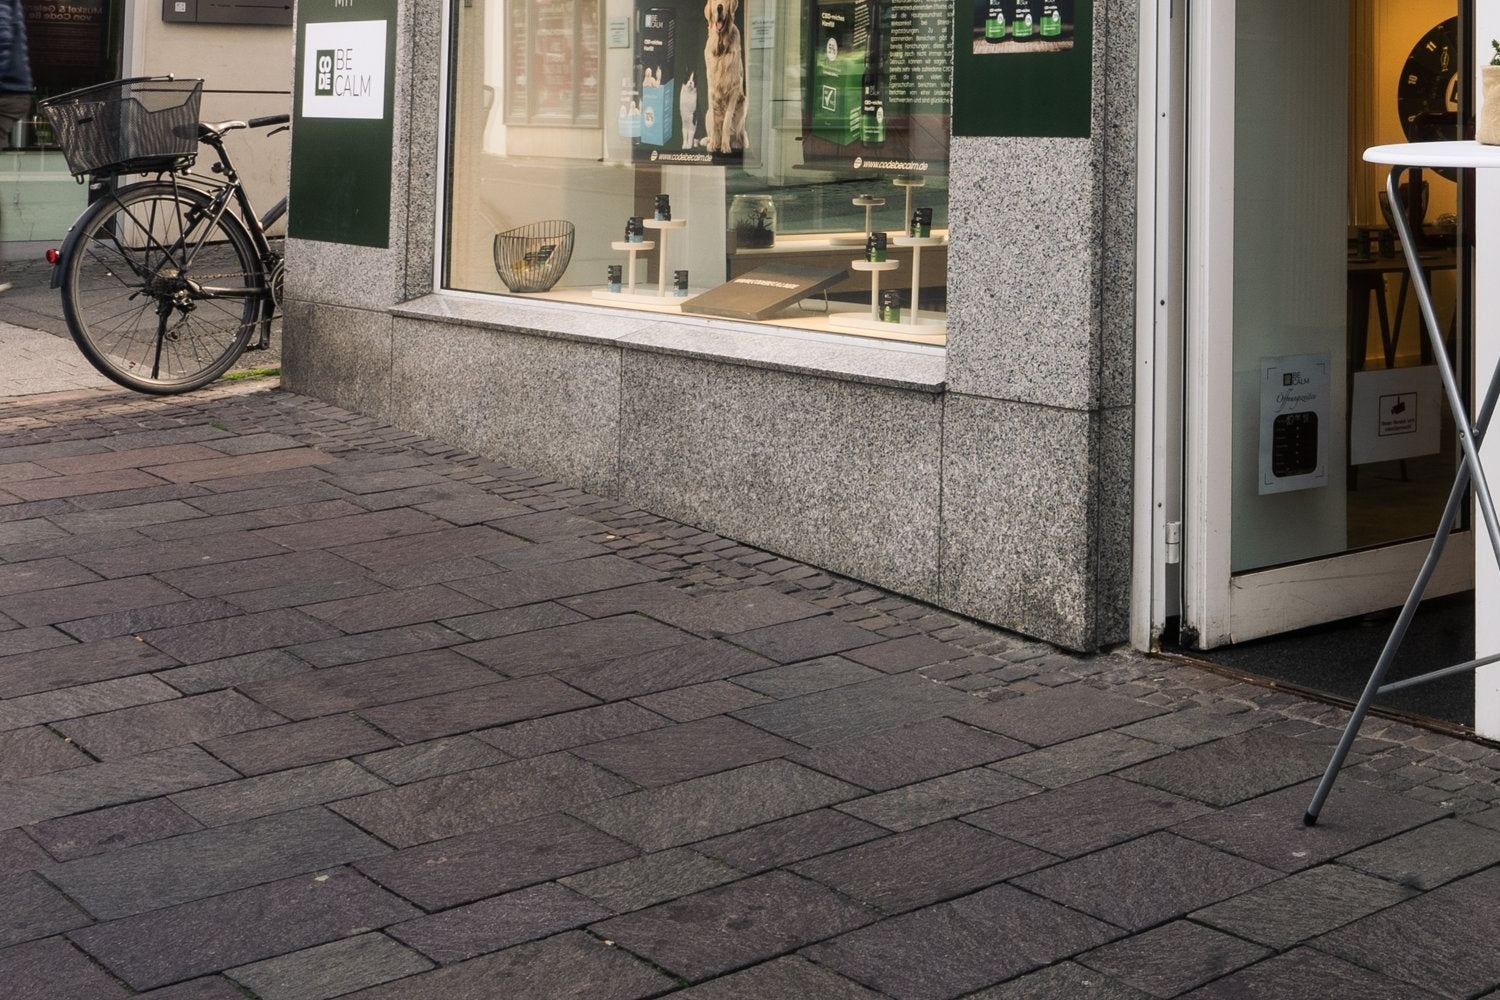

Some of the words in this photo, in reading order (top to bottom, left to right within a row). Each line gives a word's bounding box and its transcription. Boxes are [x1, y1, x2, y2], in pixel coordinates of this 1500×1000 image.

[337, 48, 353, 70] BE
[1408, 74, 1418, 85] 10
[335, 75, 371, 97] CALM
[659, 153, 713, 162] www.codebecalm.de
[863, 160, 928, 171] www.codebecalm.de
